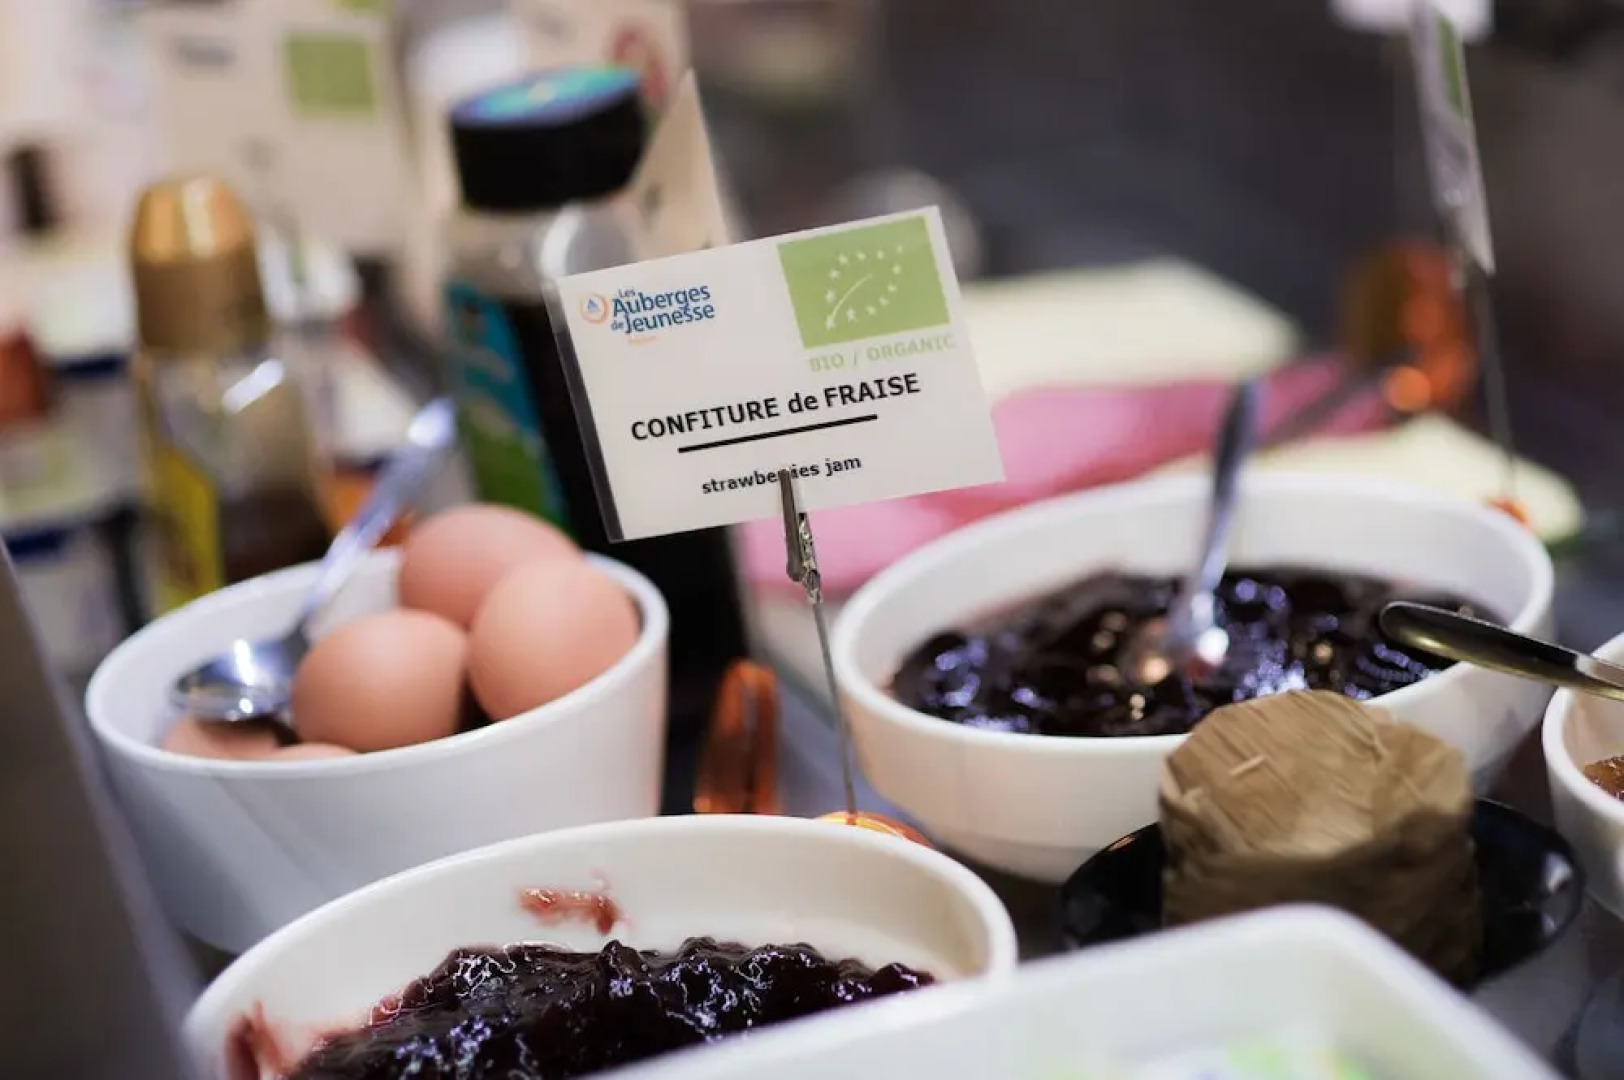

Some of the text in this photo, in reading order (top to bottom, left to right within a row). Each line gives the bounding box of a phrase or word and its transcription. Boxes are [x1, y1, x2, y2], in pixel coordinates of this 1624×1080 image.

[612, 285, 711, 317] Auberges
[619, 286, 636, 298] Les
[611, 304, 716, 334] de Jeunesse
[809, 355, 844, 373] BIO
[867, 333, 956, 361] ORGANIC
[631, 372, 921, 441] CONFITURE de FRAISE
[702, 457, 862, 494] strawbeies jam
